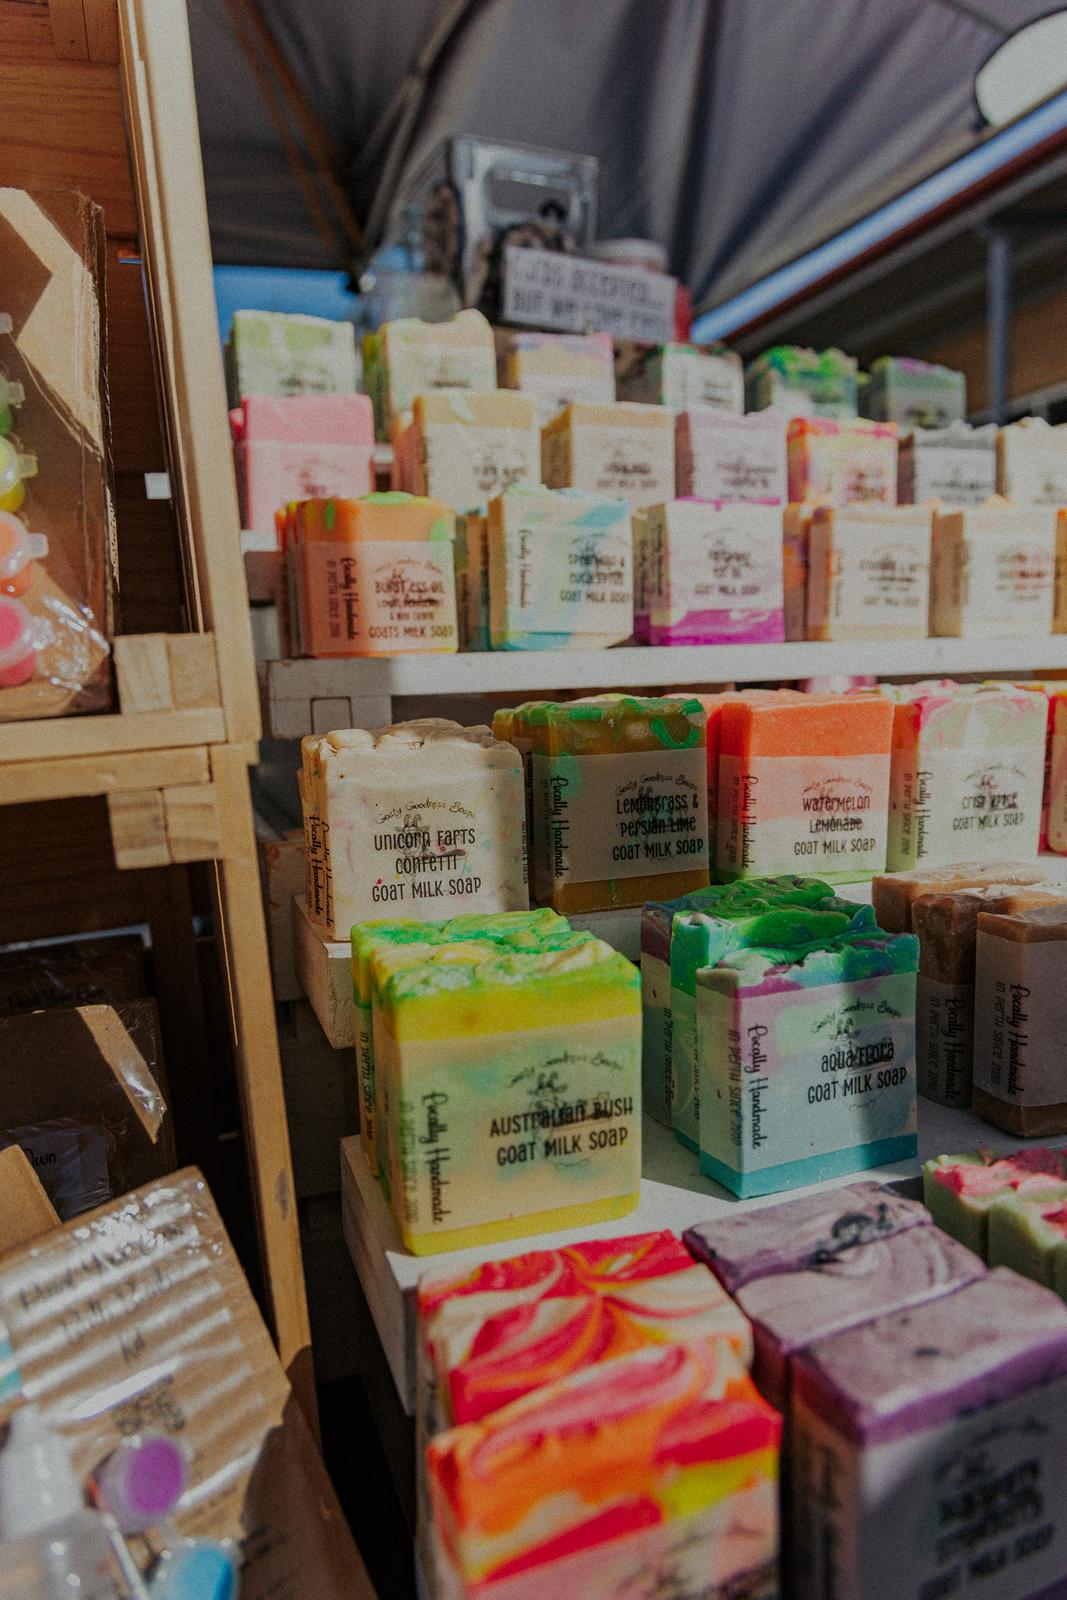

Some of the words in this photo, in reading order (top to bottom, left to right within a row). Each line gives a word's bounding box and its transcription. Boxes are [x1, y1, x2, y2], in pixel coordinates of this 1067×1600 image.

[612, 844, 641, 861] GOAT
[645, 841, 672, 858] MILK
[676, 838, 704, 855] SOAP
[794, 840, 818, 855] GOAT
[823, 838, 847, 854] MILK
[851, 838, 876, 852] SOAP
[372, 883, 406, 903] GOAT
[411, 880, 443, 899] MILK
[449, 876, 482, 895] SOAP
[1006, 983, 1031, 1028] Locally
[744, 1023, 768, 1074] Locally
[1007, 1031, 1028, 1096] Handmade
[808, 1080, 839, 1104] GOAT
[843, 1074, 873, 1097] MILK
[877, 1066, 907, 1089] SOAP
[749, 1077, 769, 1149] Handmade
[497, 1141, 536, 1166] GOAT
[544, 1134, 582, 1158] MILK
[589, 1126, 628, 1150] SOAP
